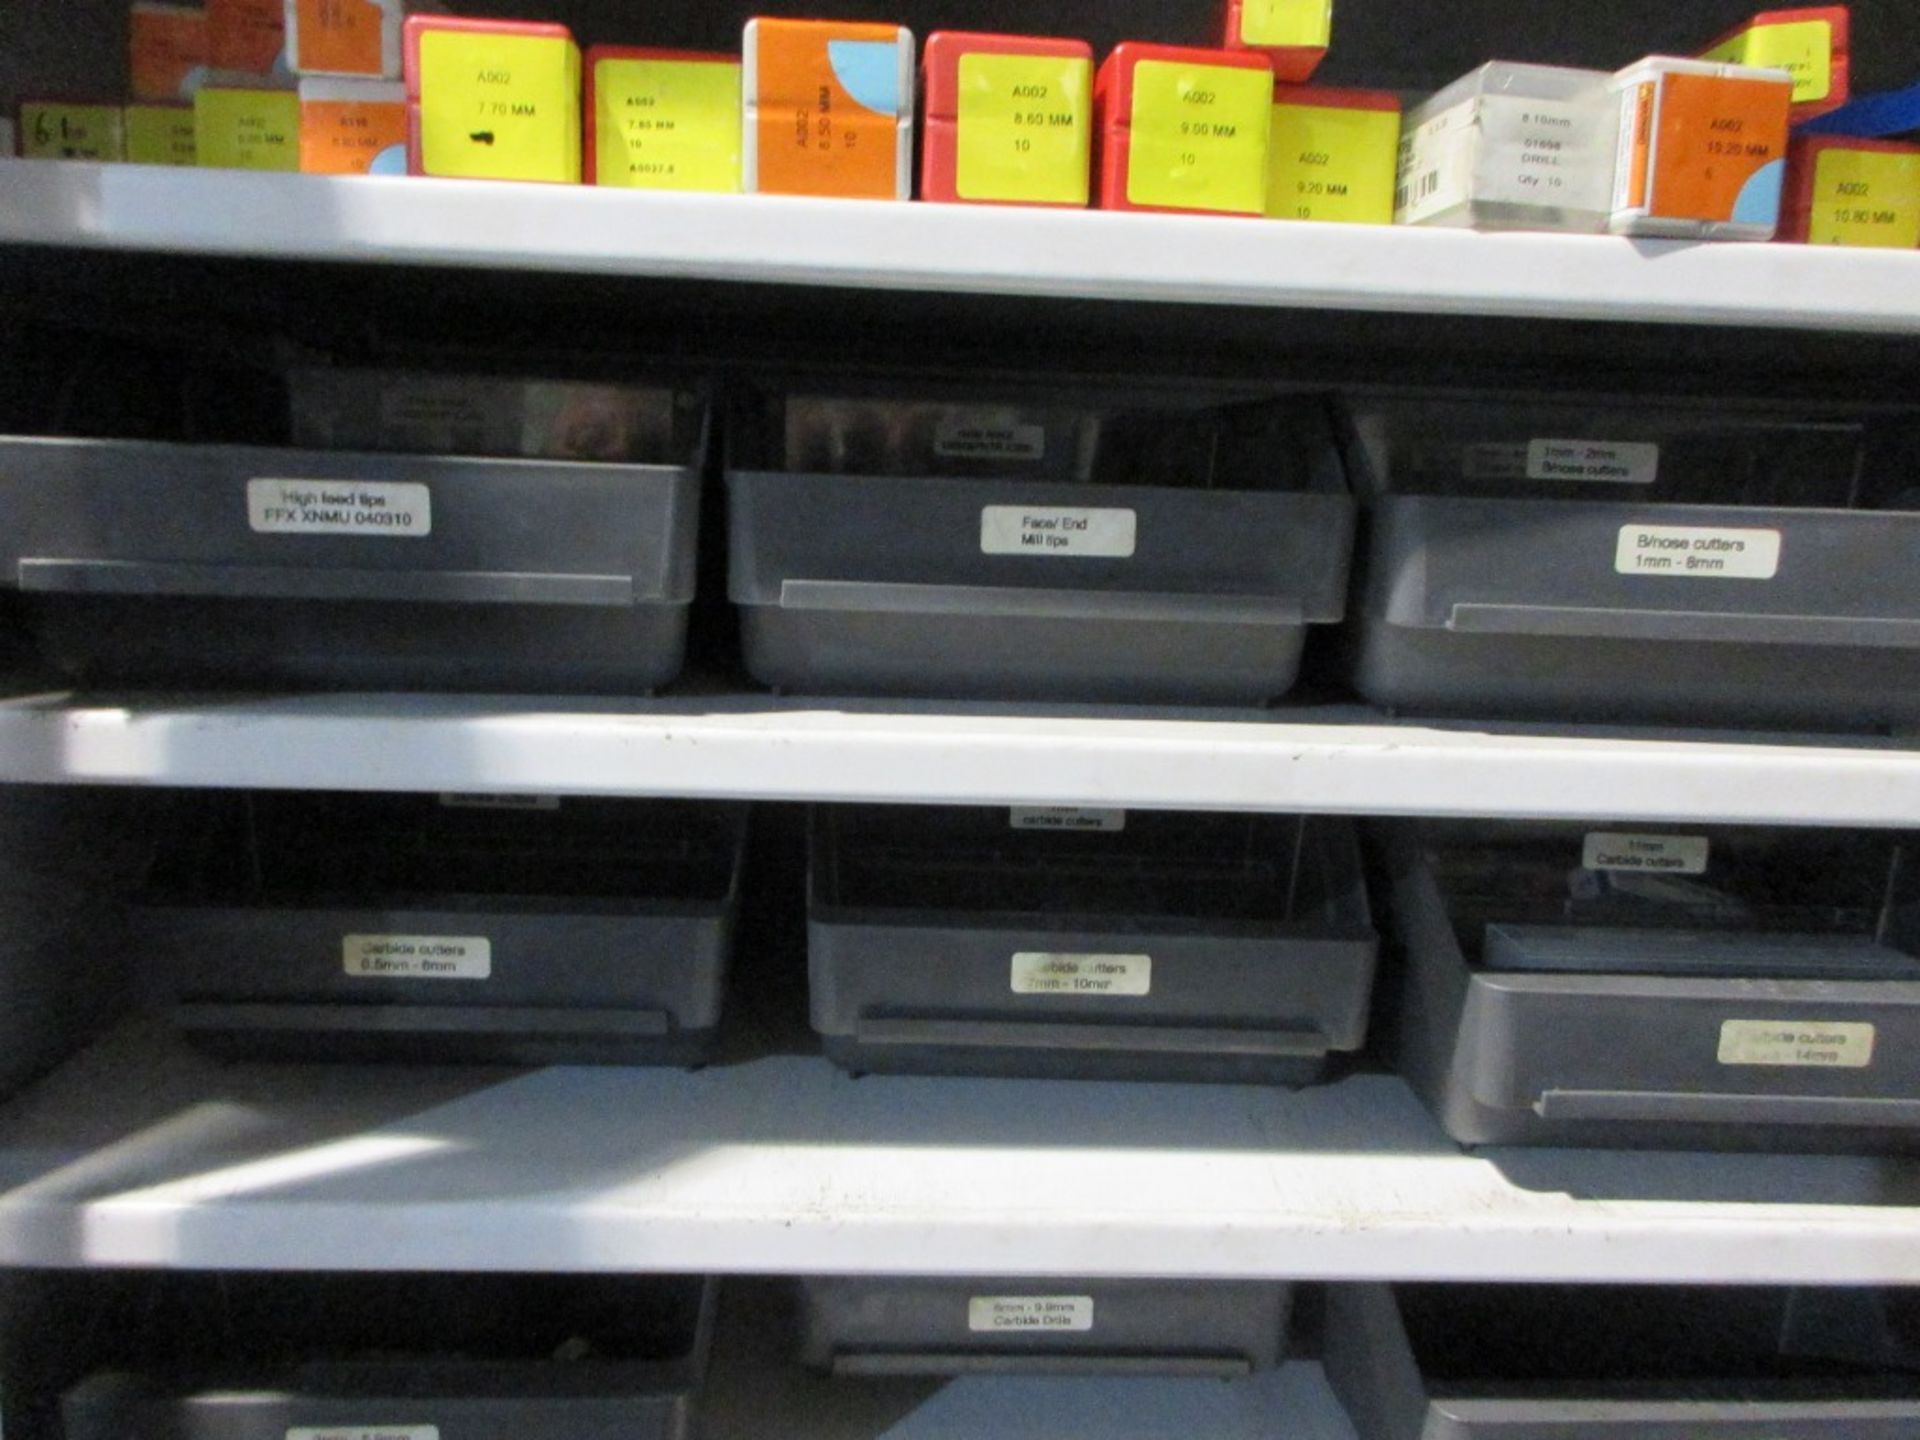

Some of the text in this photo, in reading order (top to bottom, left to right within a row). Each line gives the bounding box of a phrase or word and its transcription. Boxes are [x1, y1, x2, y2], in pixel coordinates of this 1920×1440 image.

[477, 71, 512, 85] A002
[1012, 86, 1048, 98] A002
[1183, 92, 1216, 105] A002
[819, 86, 831, 114] MM
[479, 102, 536, 117] 7.70 MM
[656, 121, 675, 130] MM
[1049, 114, 1073, 127] MM
[1710, 118, 1744, 132] A002
[796, 108, 809, 149] A002
[1213, 124, 1236, 138] MM
[1015, 139, 1031, 152] 10
[1745, 145, 1769, 157] MM
[1181, 153, 1196, 166] 10
[1299, 154, 1329, 166] A002
[1297, 182, 1348, 196] 9.20 MM
[1836, 182, 1870, 196] A002
[1297, 207, 1311, 219] 10
[1872, 211, 1896, 224] MM
[282, 490, 318, 506] High
[264, 508, 296, 522] FFX
[301, 509, 350, 524] XNMU
[1062, 516, 1088, 530] End
[1021, 534, 1069, 548] Mill tips
[1637, 533, 1745, 552] B/nose cutters
[1636, 555, 1672, 568] 1mm
